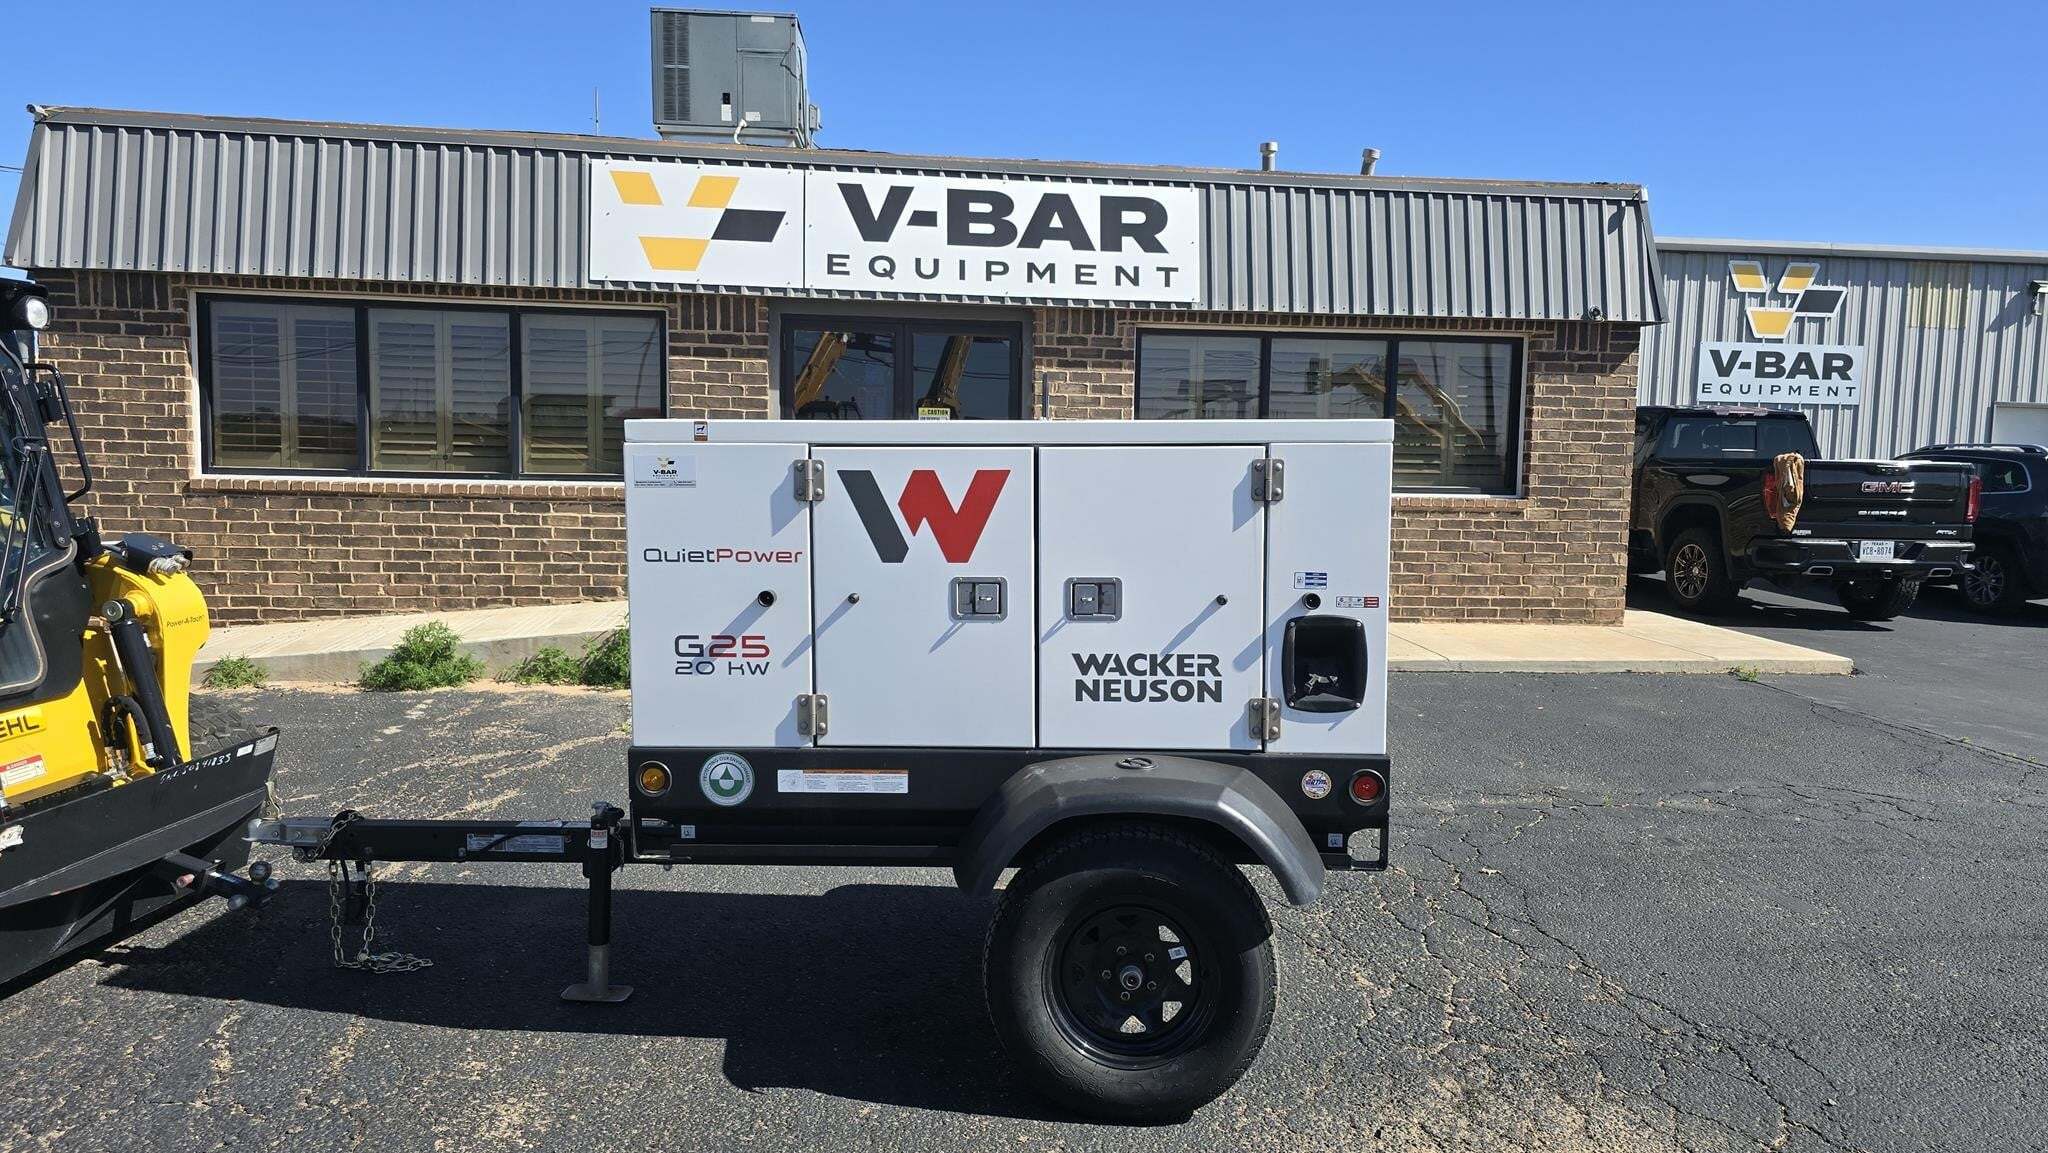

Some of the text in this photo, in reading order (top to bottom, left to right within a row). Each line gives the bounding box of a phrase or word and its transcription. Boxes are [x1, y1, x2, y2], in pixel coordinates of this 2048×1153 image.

[837, 182, 1170, 254] V-BAR
[826, 253, 1180, 289] EQUIPMENT
[1709, 349, 1854, 381] V-BAR
[1701, 382, 1857, 398] EQUIPMENT
[1861, 481, 1915, 494] GMC
[643, 548, 803, 564] QuietPower
[674, 634, 770, 658] G25
[675, 660, 715, 675] 20
[1072, 653, 1222, 677] WACKER
[1075, 679, 1222, 703] NEUSON
